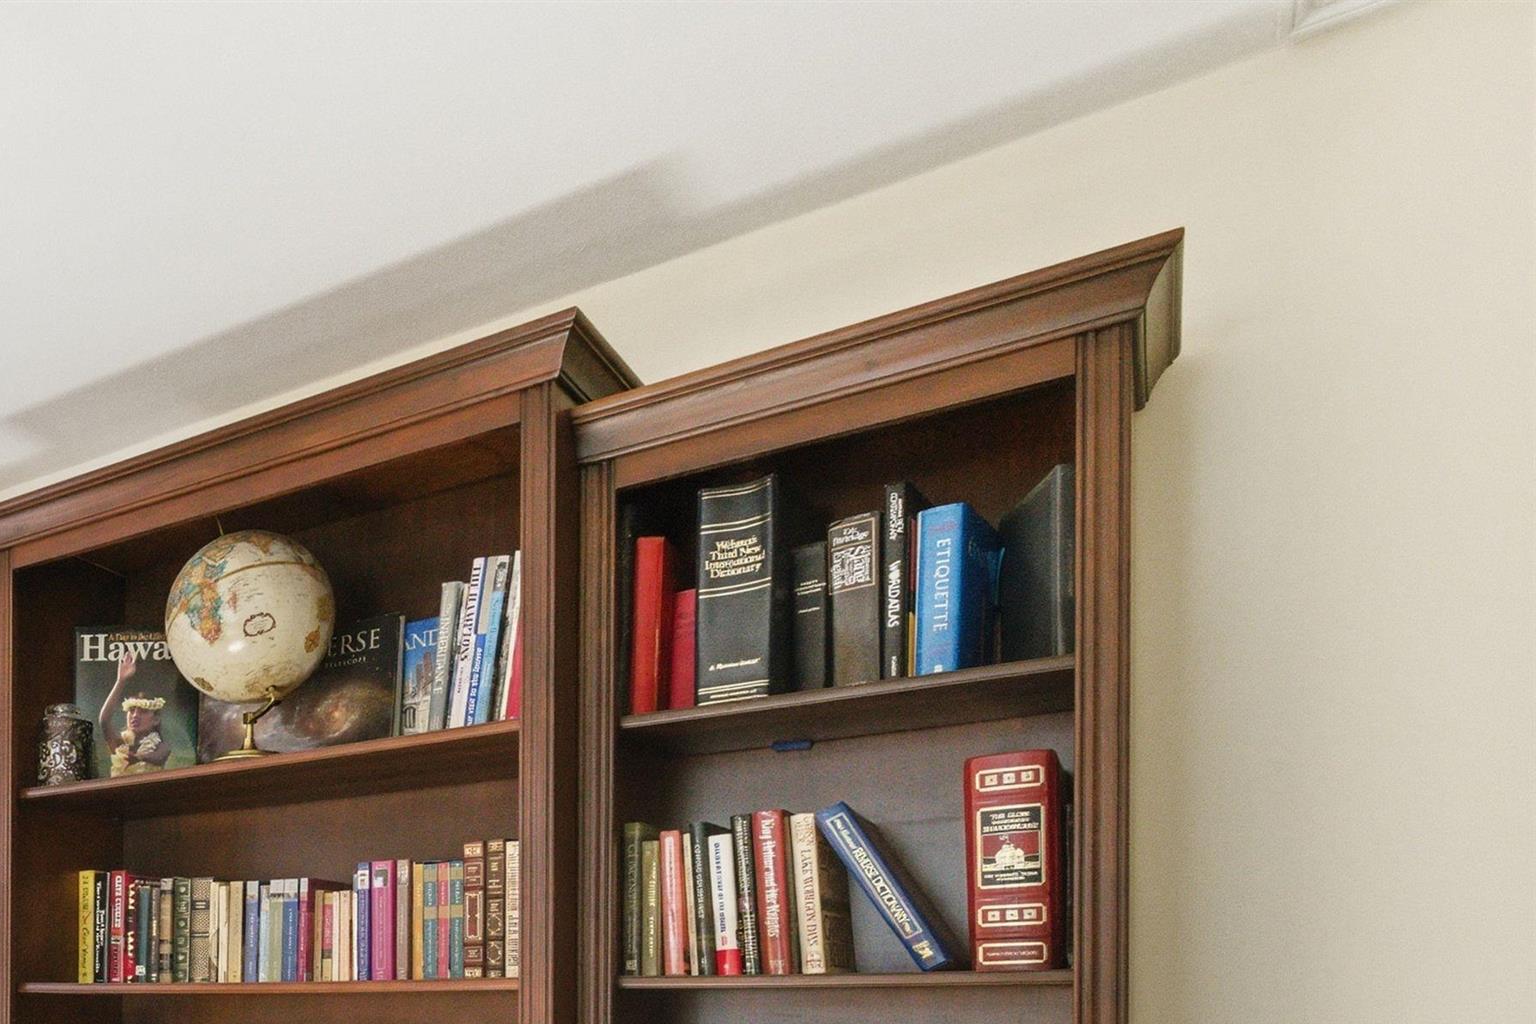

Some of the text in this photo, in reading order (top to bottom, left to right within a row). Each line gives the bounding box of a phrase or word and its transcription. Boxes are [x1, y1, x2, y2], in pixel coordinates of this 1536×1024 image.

[709, 545, 761, 560] Third New
[715, 535, 758, 551] Webster's
[705, 549, 766, 570] International
[710, 563, 762, 578] Dictionary
[887, 559, 902, 628] WORLD ATLAS
[932, 537, 952, 633] ETIQUETTE
[460, 592, 477, 662] HAMPTONS
[80, 633, 173, 662] Hawa
[327, 628, 381, 657] ERSE
[433, 615, 450, 695] INHERITANCE
[800, 848, 814, 874] LAKE
[801, 877, 817, 922] WOBEGON
[853, 846, 910, 926] REVERSE DICTIONARY
